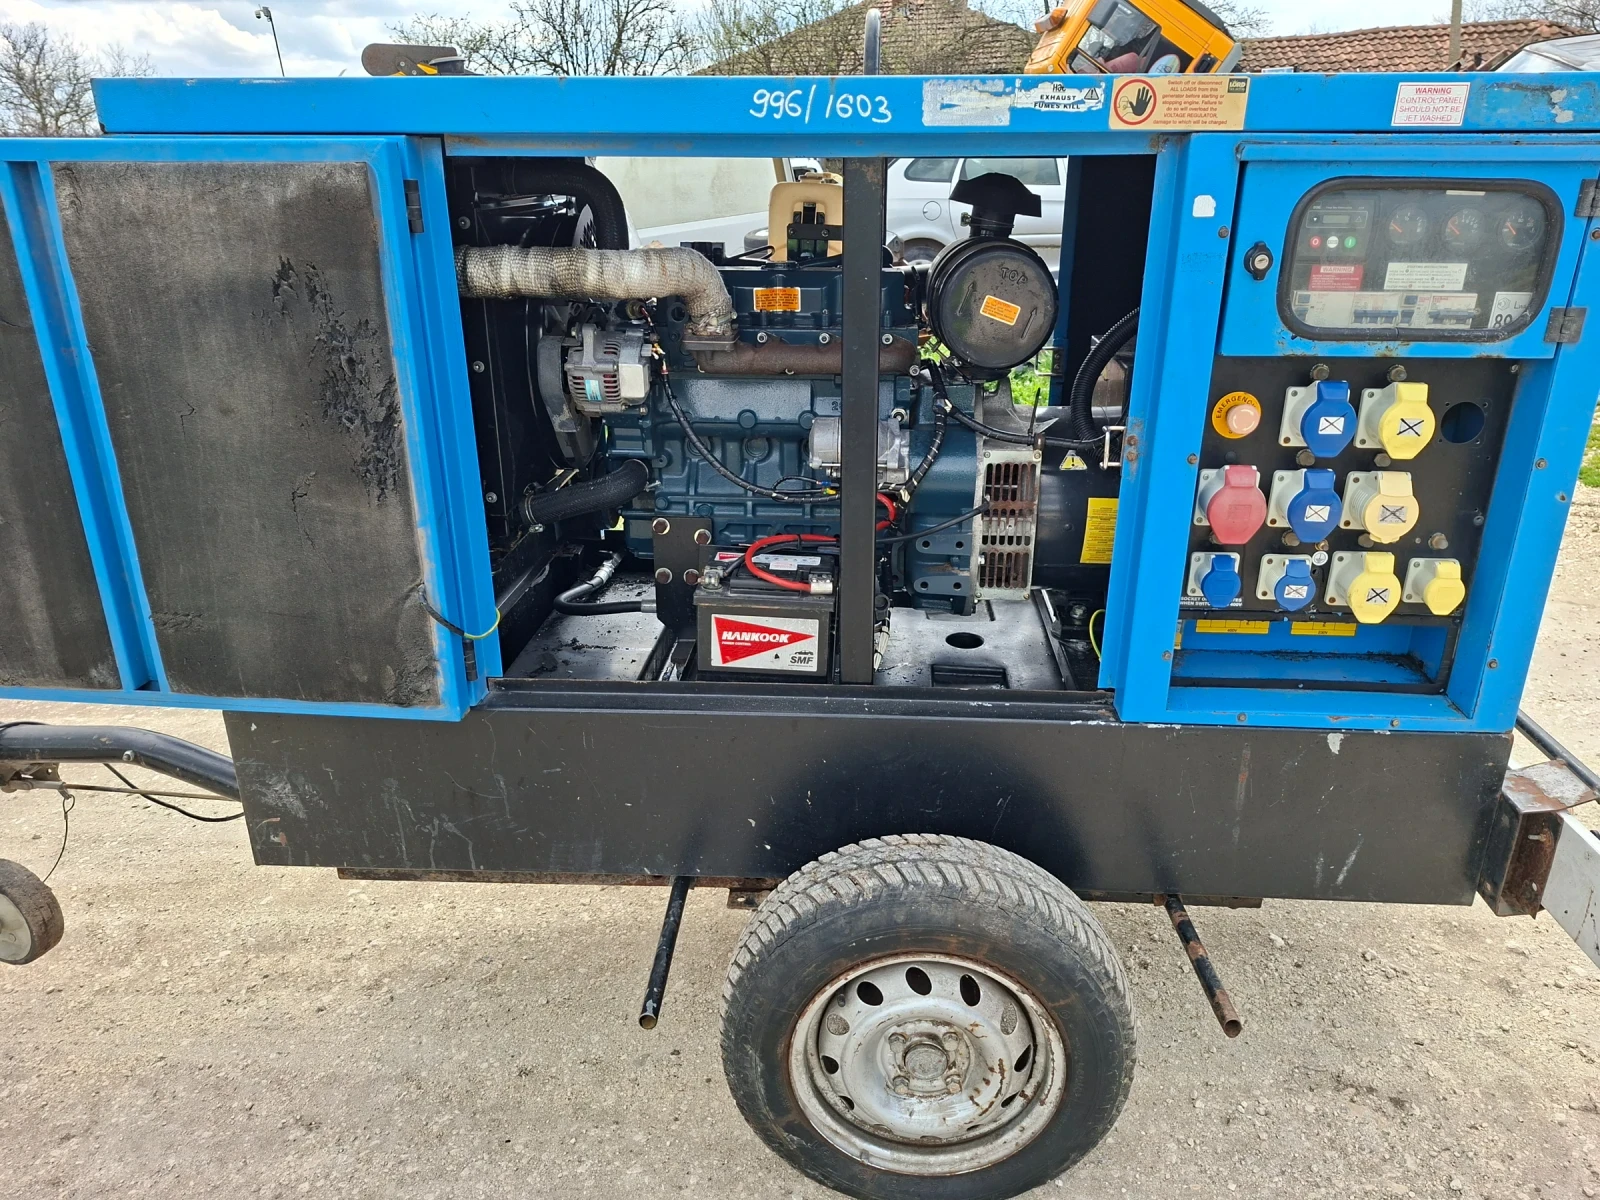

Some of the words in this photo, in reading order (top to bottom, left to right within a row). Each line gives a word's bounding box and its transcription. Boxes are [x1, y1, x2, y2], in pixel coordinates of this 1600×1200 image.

[1001, 267, 1028, 285] TOP
[722, 631, 791, 643] HANKOOK
[790, 656, 814, 664] SMF
